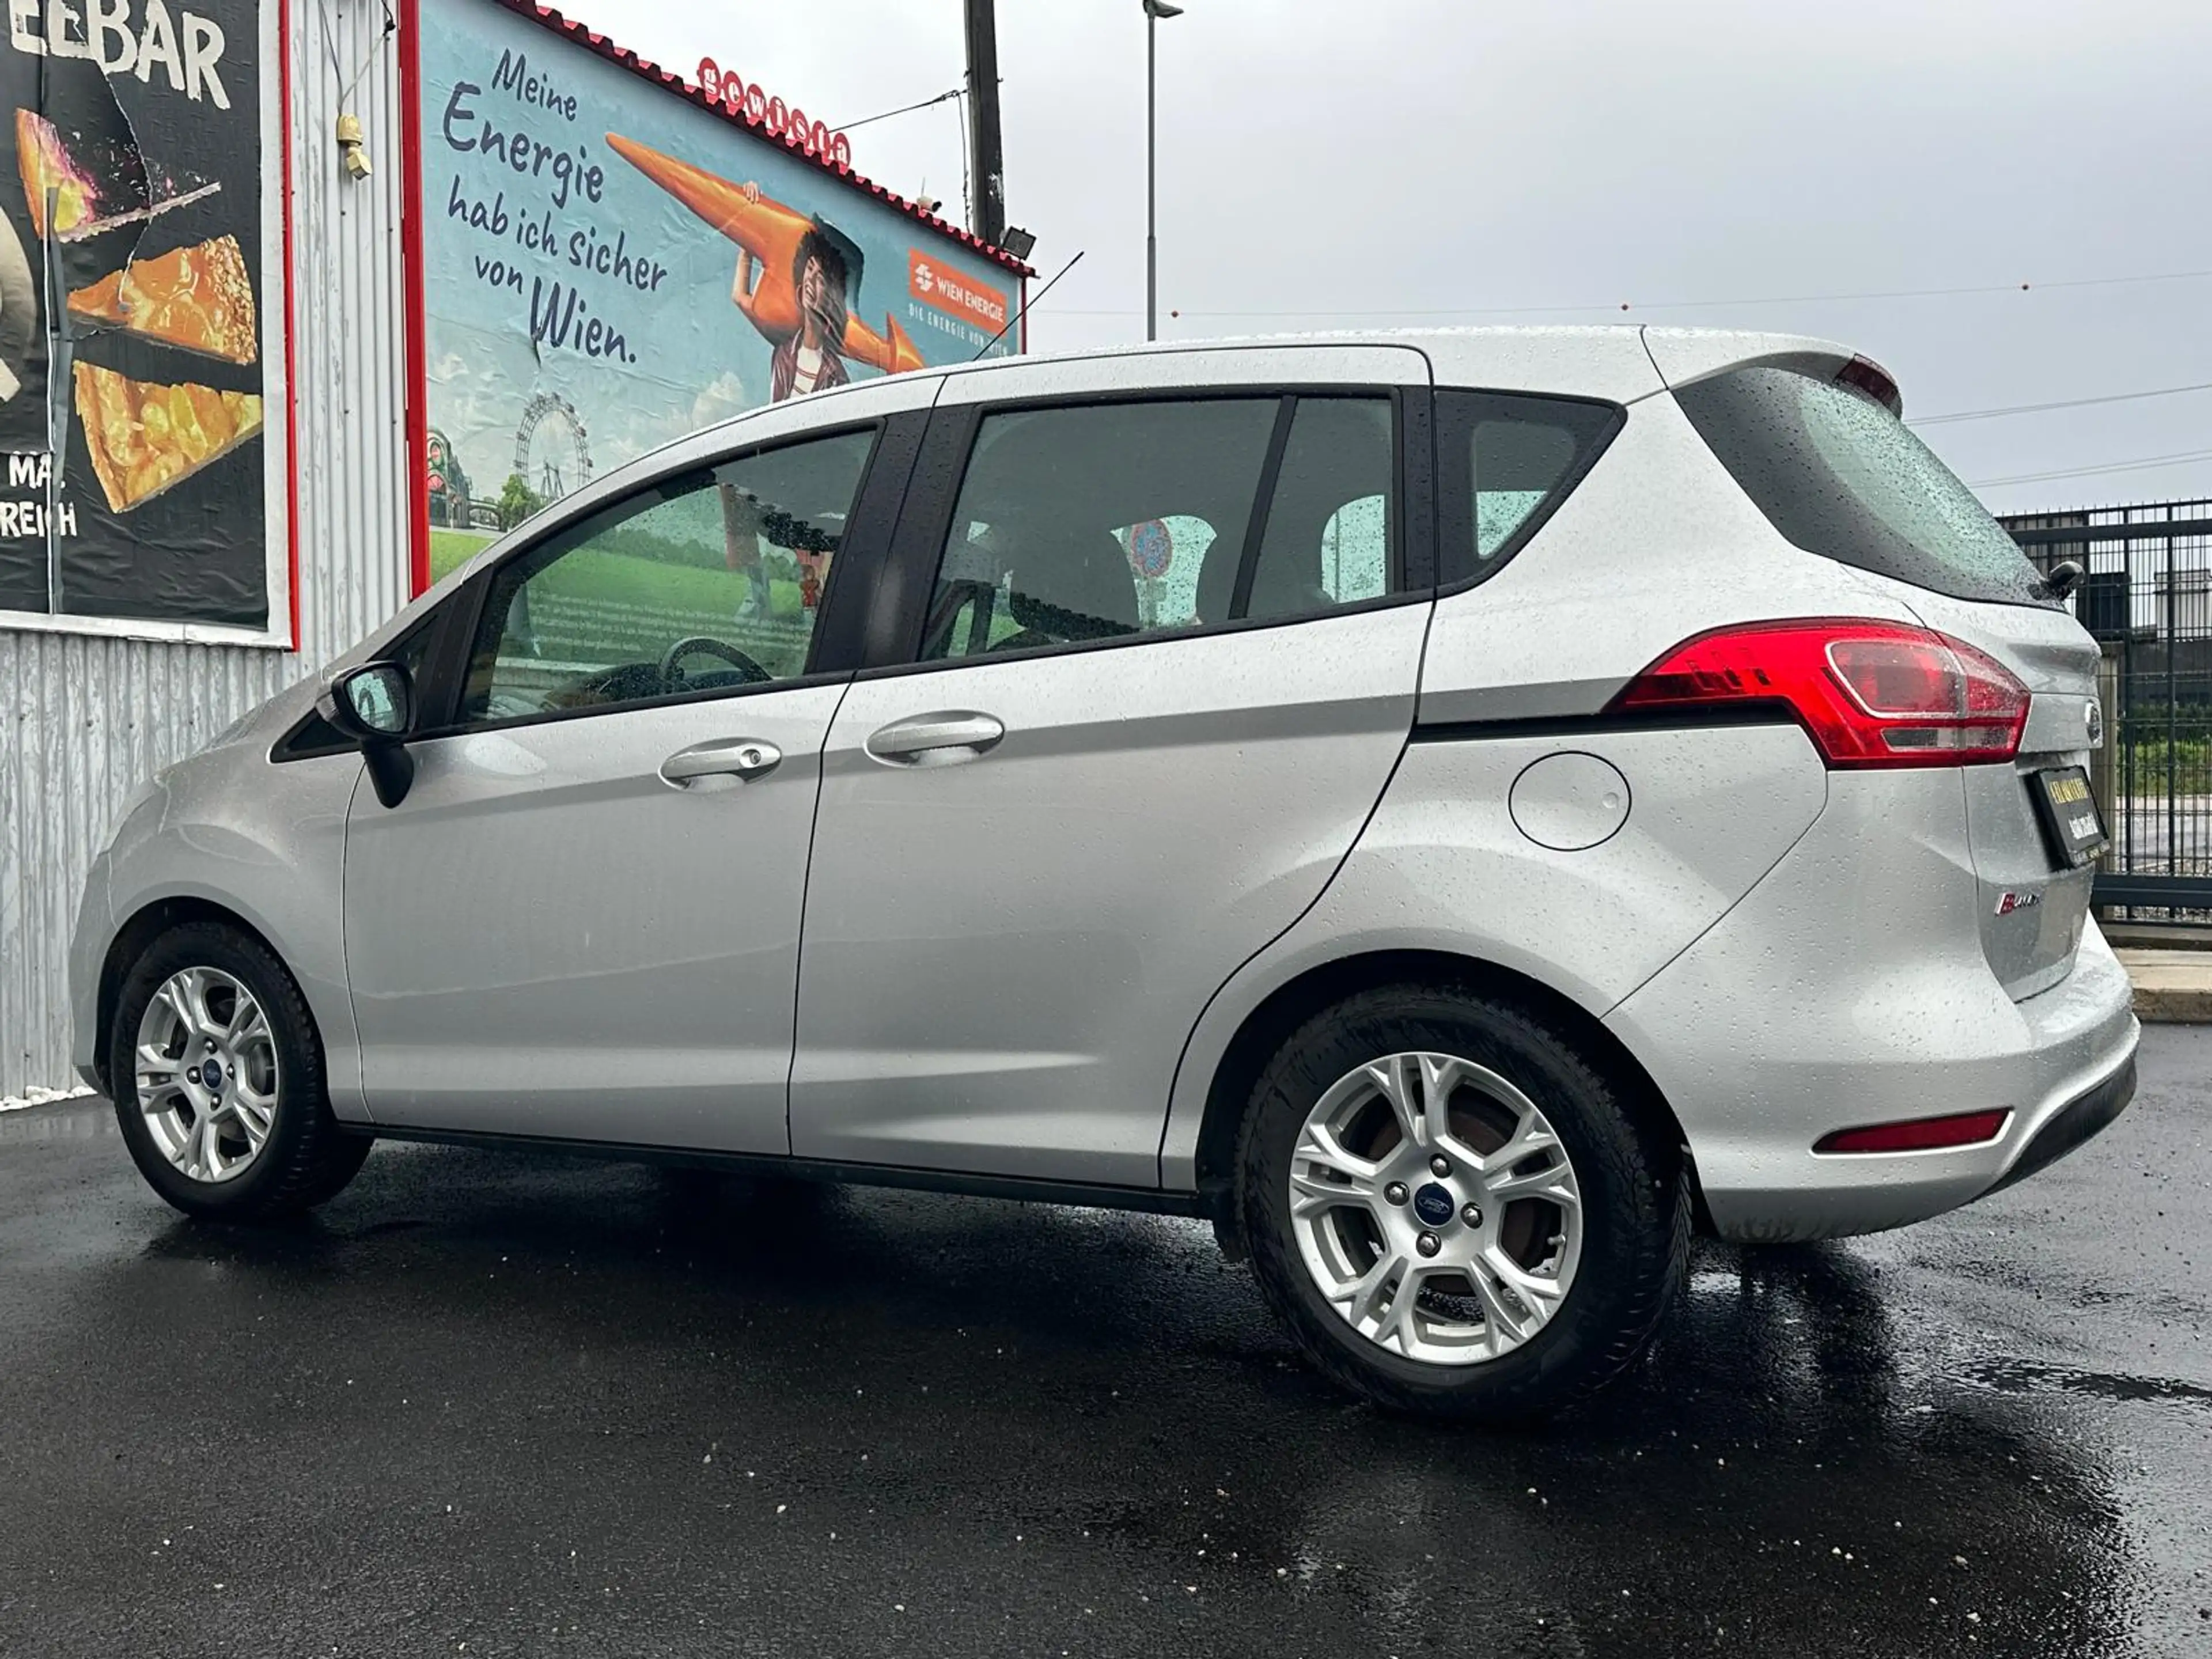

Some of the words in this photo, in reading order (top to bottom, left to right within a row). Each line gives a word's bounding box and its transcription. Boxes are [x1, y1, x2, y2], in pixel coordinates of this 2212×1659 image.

[493, 49, 577, 120] Meine
[703, 66, 849, 166] gewista
[442, 82, 604, 209] Energie
[448, 175, 507, 234] hab
[517, 209, 558, 256] ich
[569, 227, 666, 291] sicher
[475, 256, 523, 294] von
[530, 276, 637, 363] Wien.
[927, 310, 965, 340] ENERGIE
[937, 276, 964, 305] WIEN
[965, 290, 1003, 323] ENERGIE
